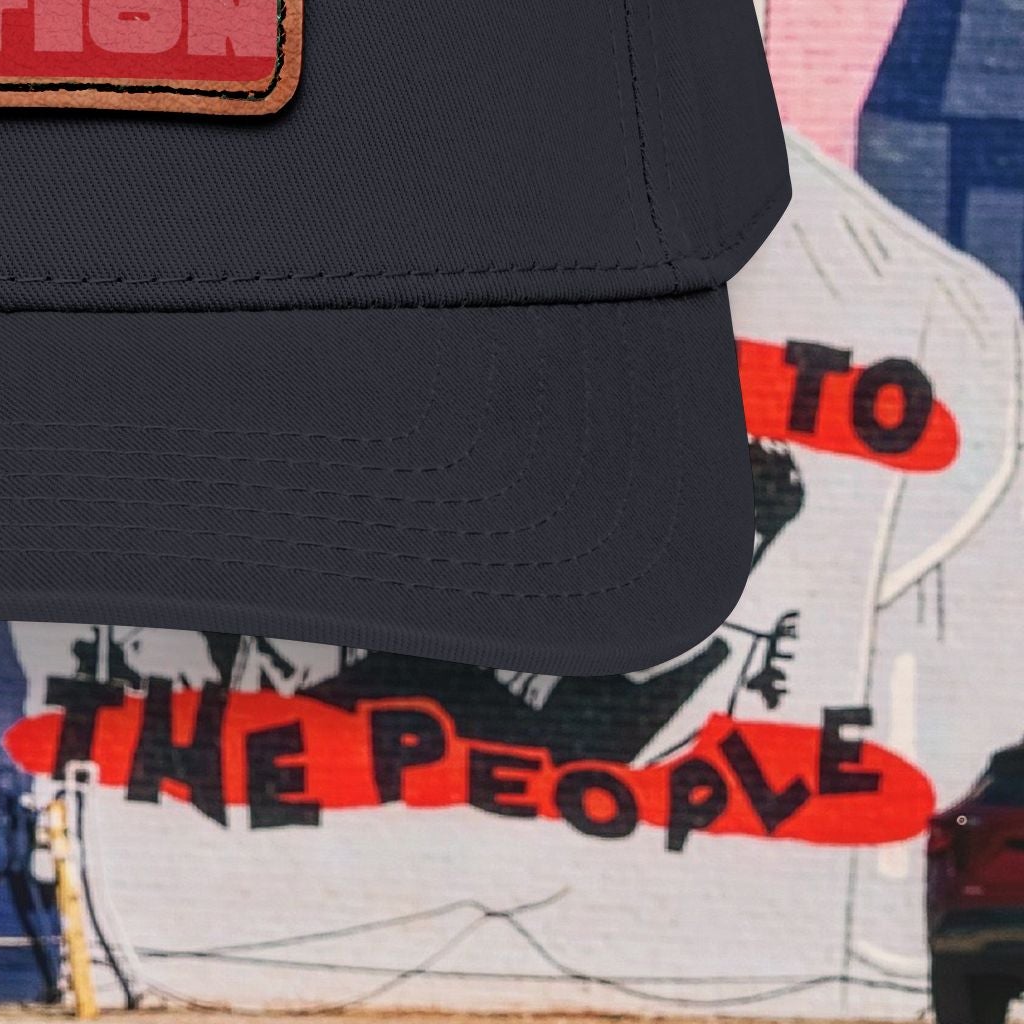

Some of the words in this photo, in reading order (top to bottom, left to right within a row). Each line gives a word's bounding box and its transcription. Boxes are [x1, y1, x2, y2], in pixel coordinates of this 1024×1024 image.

[785, 339, 934, 454] TO
[46, 676, 320, 829] THE
[370, 706, 881, 852] PEOPLE
